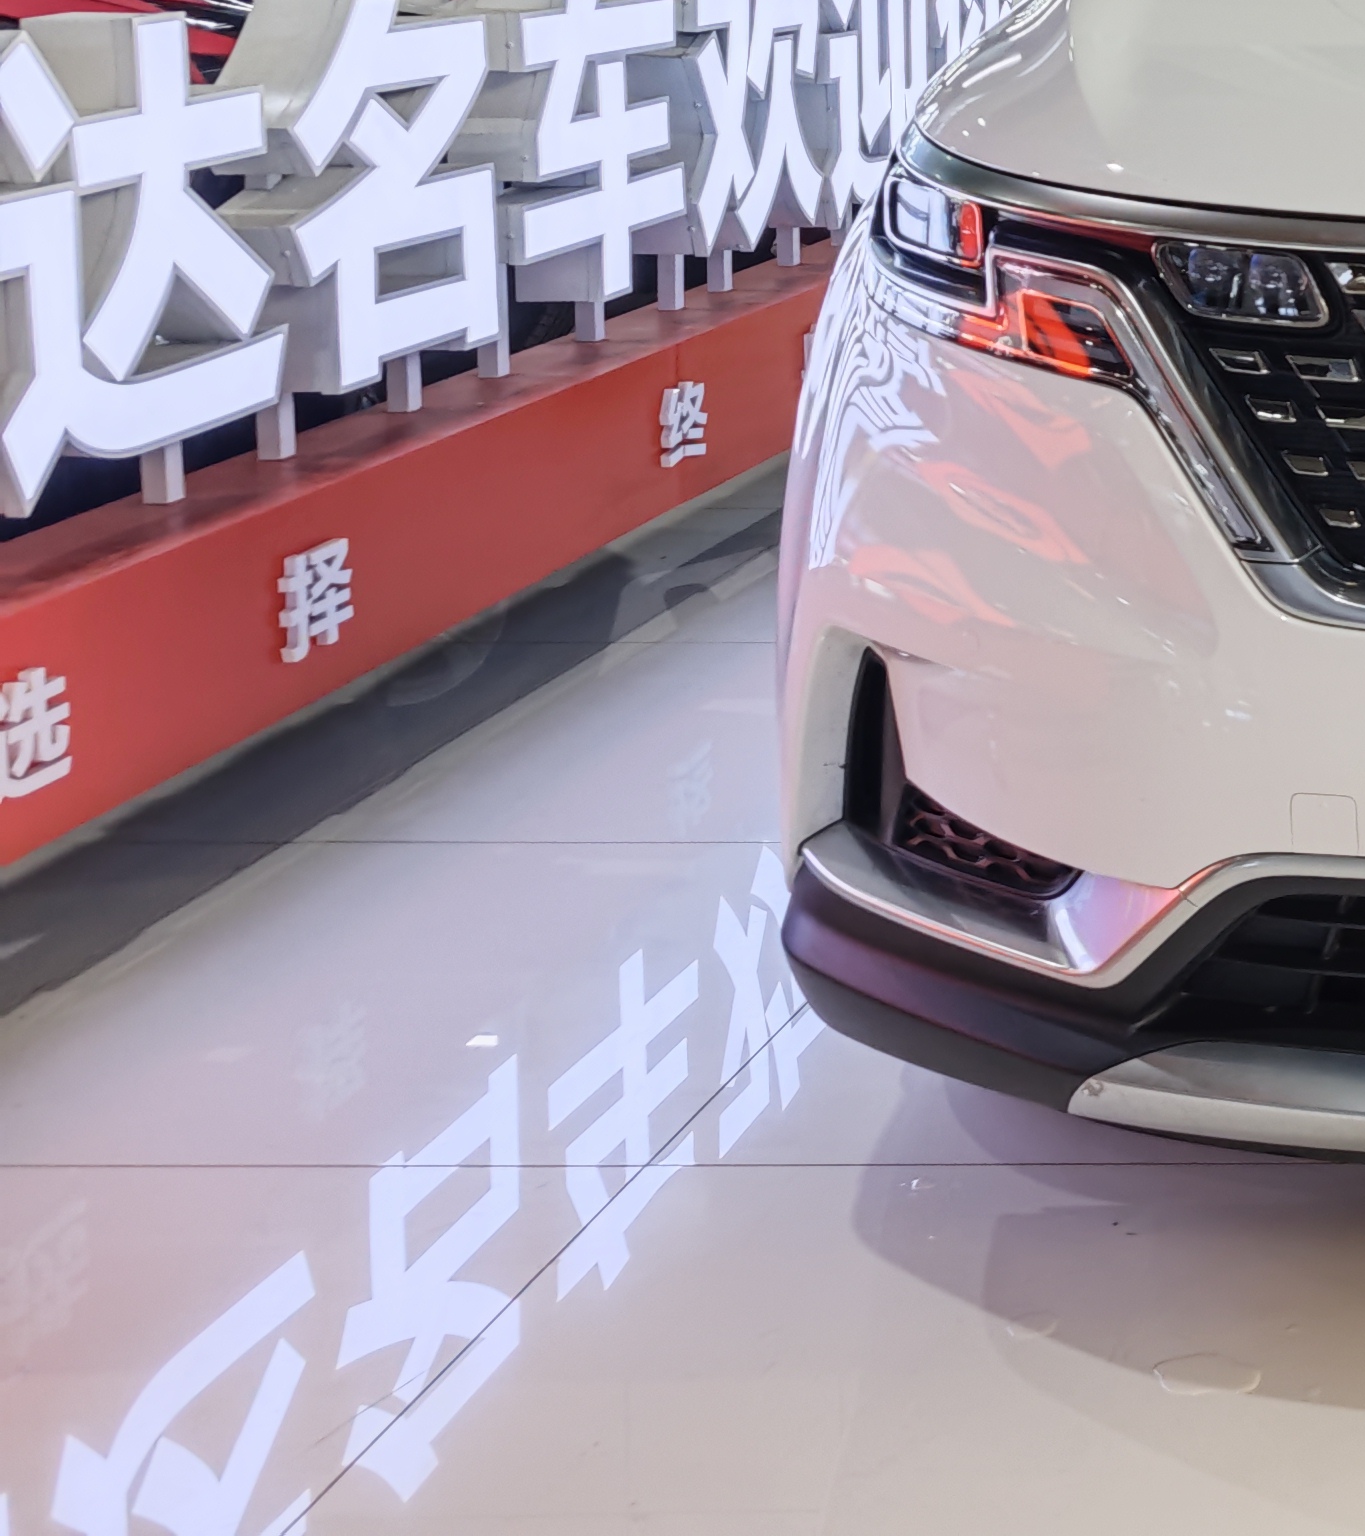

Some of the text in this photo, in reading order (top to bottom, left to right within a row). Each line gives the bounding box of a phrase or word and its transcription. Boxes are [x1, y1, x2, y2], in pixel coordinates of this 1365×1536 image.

[0, 380, 708, 801] 选 择 终
